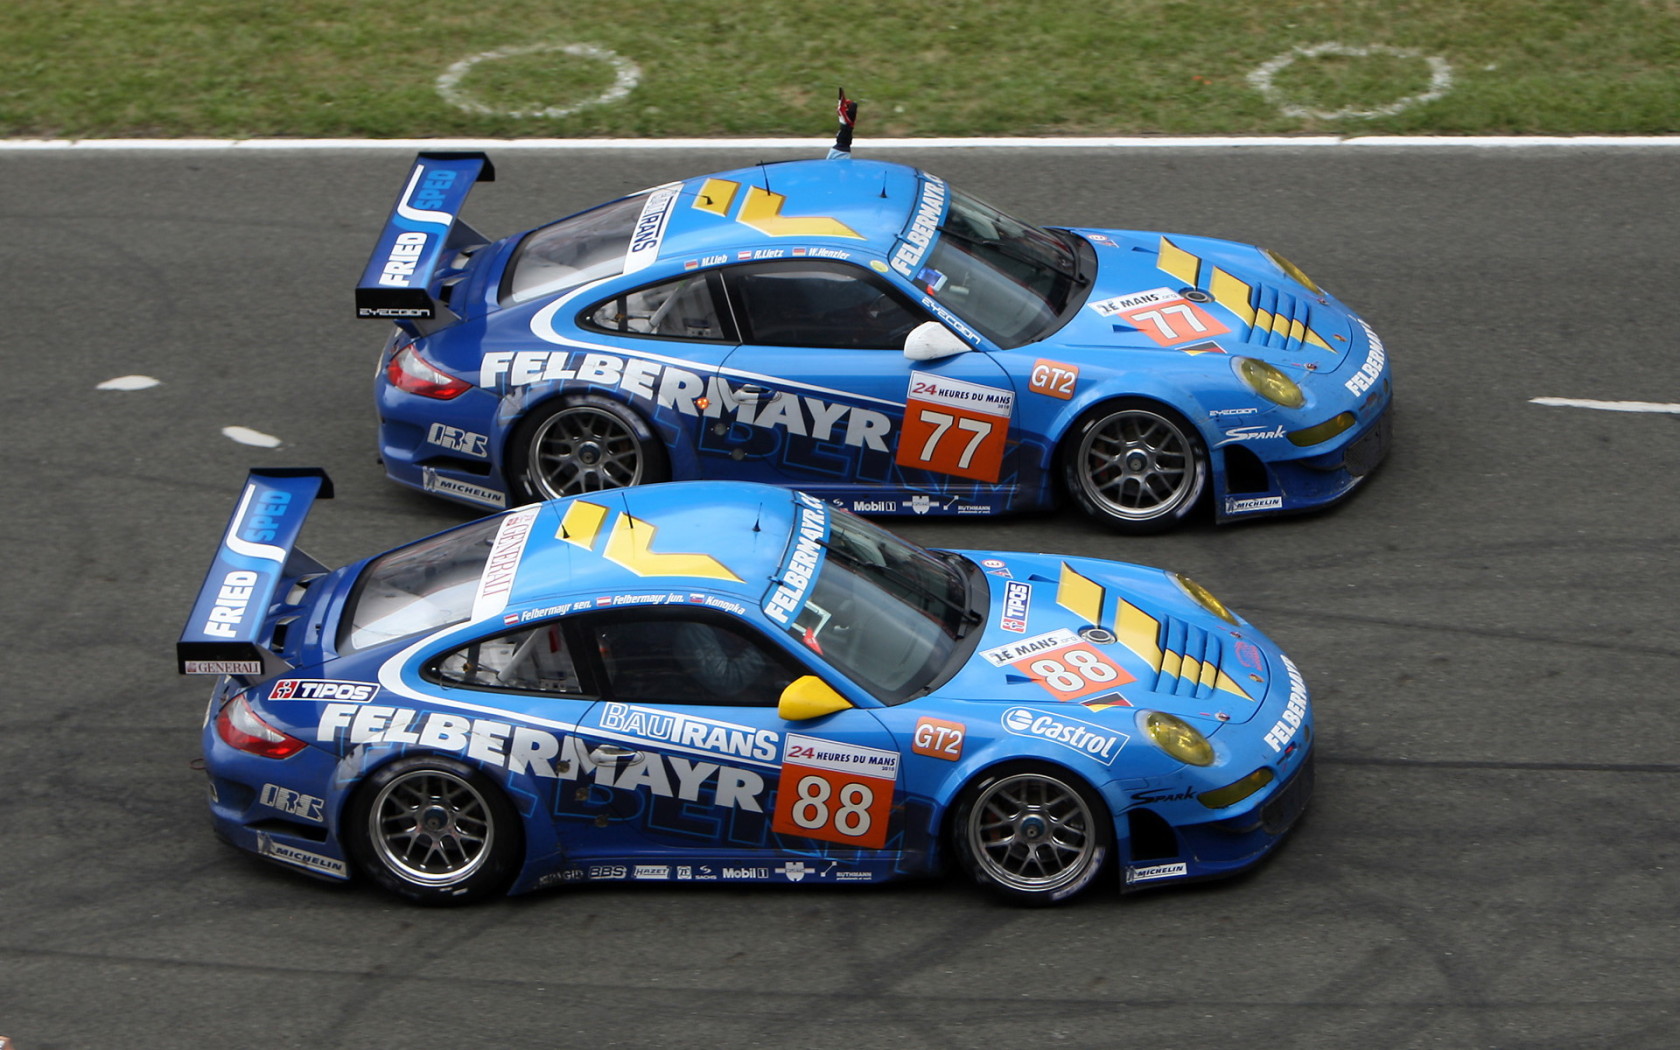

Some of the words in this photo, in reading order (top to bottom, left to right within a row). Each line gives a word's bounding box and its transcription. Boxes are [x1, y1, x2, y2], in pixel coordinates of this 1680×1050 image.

[413, 169, 457, 210] SPED
[378, 232, 428, 288] FRIED
[753, 248, 784, 259] R.Lietz
[808, 247, 851, 260] W.Henzler
[1121, 294, 1160, 308] MANS
[1129, 303, 1208, 340] 77
[1031, 364, 1077, 395] GT2
[479, 350, 890, 453] FELBERMAYR
[912, 382, 938, 395] 24
[938, 388, 969, 400] HEURES
[972, 393, 984, 402] DU
[985, 395, 1011, 405] MANS
[919, 409, 993, 470] 77
[440, 480, 503, 502] MICHELIN
[854, 501, 885, 511] Mobil
[1236, 499, 1280, 508] MICHELIN
[243, 489, 292, 542] SPED
[203, 570, 258, 638] FRIED
[705, 596, 745, 615] Konopka
[1007, 583, 1028, 618] TIPOS
[1015, 637, 1058, 656] MANS
[198, 662, 259, 674] GENERALI
[1030, 650, 1118, 693] 88
[301, 683, 373, 700] TIPOS
[599, 701, 780, 762] BAUTRANS
[914, 722, 963, 755] GT2
[1031, 715, 1118, 759] Castrol
[315, 702, 765, 814] FELBERMAYR
[787, 745, 815, 760] 24
[816, 752, 851, 763] HEURES
[853, 755, 866, 764] DU
[868, 756, 896, 766] MANS
[791, 774, 875, 838] 88
[275, 847, 343, 871] MICHELIN
[589, 865, 627, 880] BBS
[636, 866, 669, 877] HAZET
[722, 867, 757, 879] Mobil
[1136, 865, 1184, 877] MICHELIN
